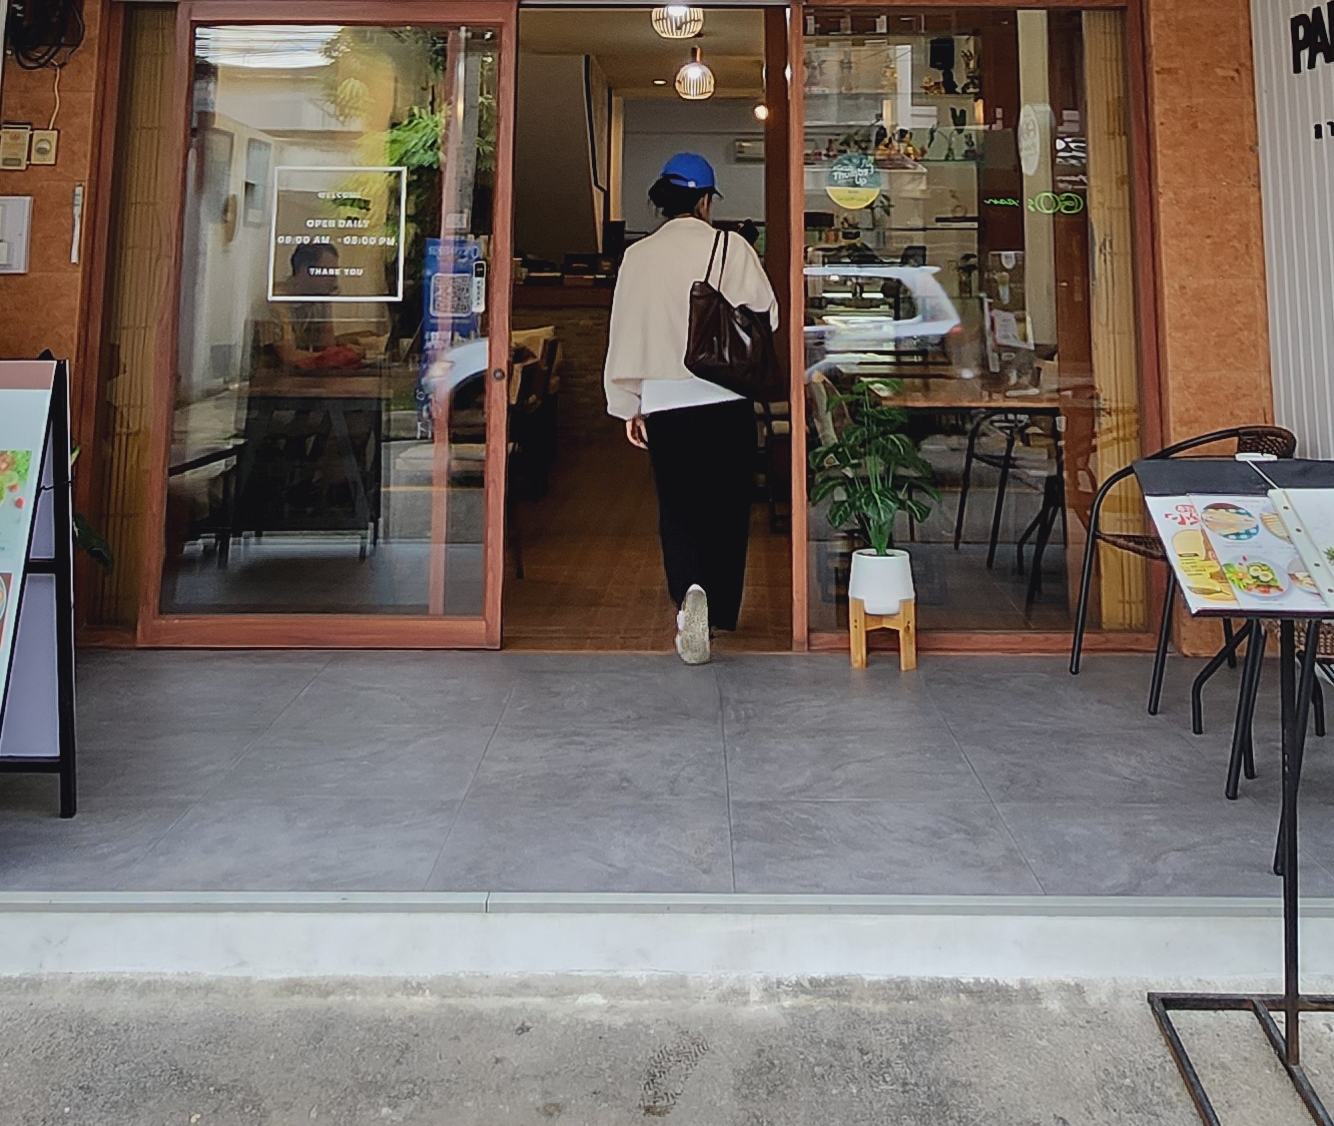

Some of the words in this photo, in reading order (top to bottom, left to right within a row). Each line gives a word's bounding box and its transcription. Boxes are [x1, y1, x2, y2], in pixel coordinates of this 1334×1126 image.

[306, 219, 336, 228] OPEN
[337, 220, 370, 228] DAILY
[308, 268, 341, 276] THANK
[343, 268, 364, 276] YOU
